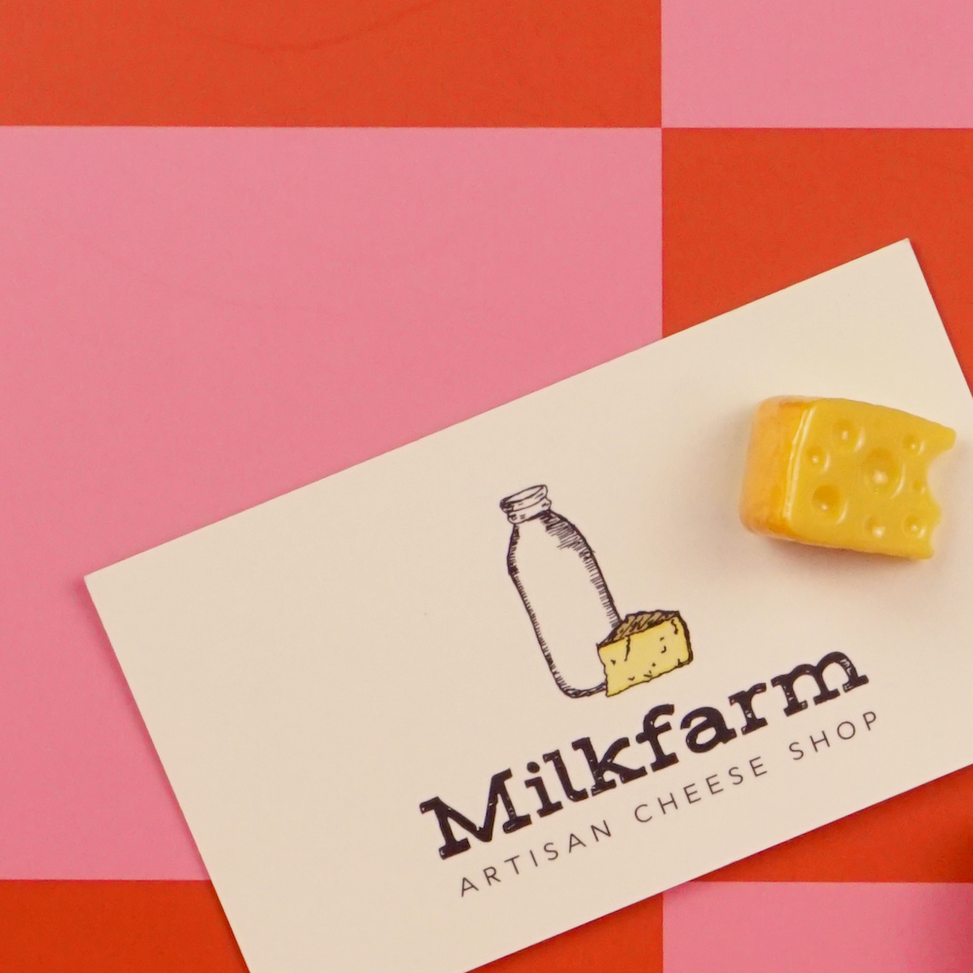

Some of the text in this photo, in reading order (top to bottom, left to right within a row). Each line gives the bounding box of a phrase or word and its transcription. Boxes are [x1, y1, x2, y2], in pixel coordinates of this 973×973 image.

[419, 650, 870, 860] Milkfarm
[460, 710, 879, 897] ARTISAN CHEESE SHOP
